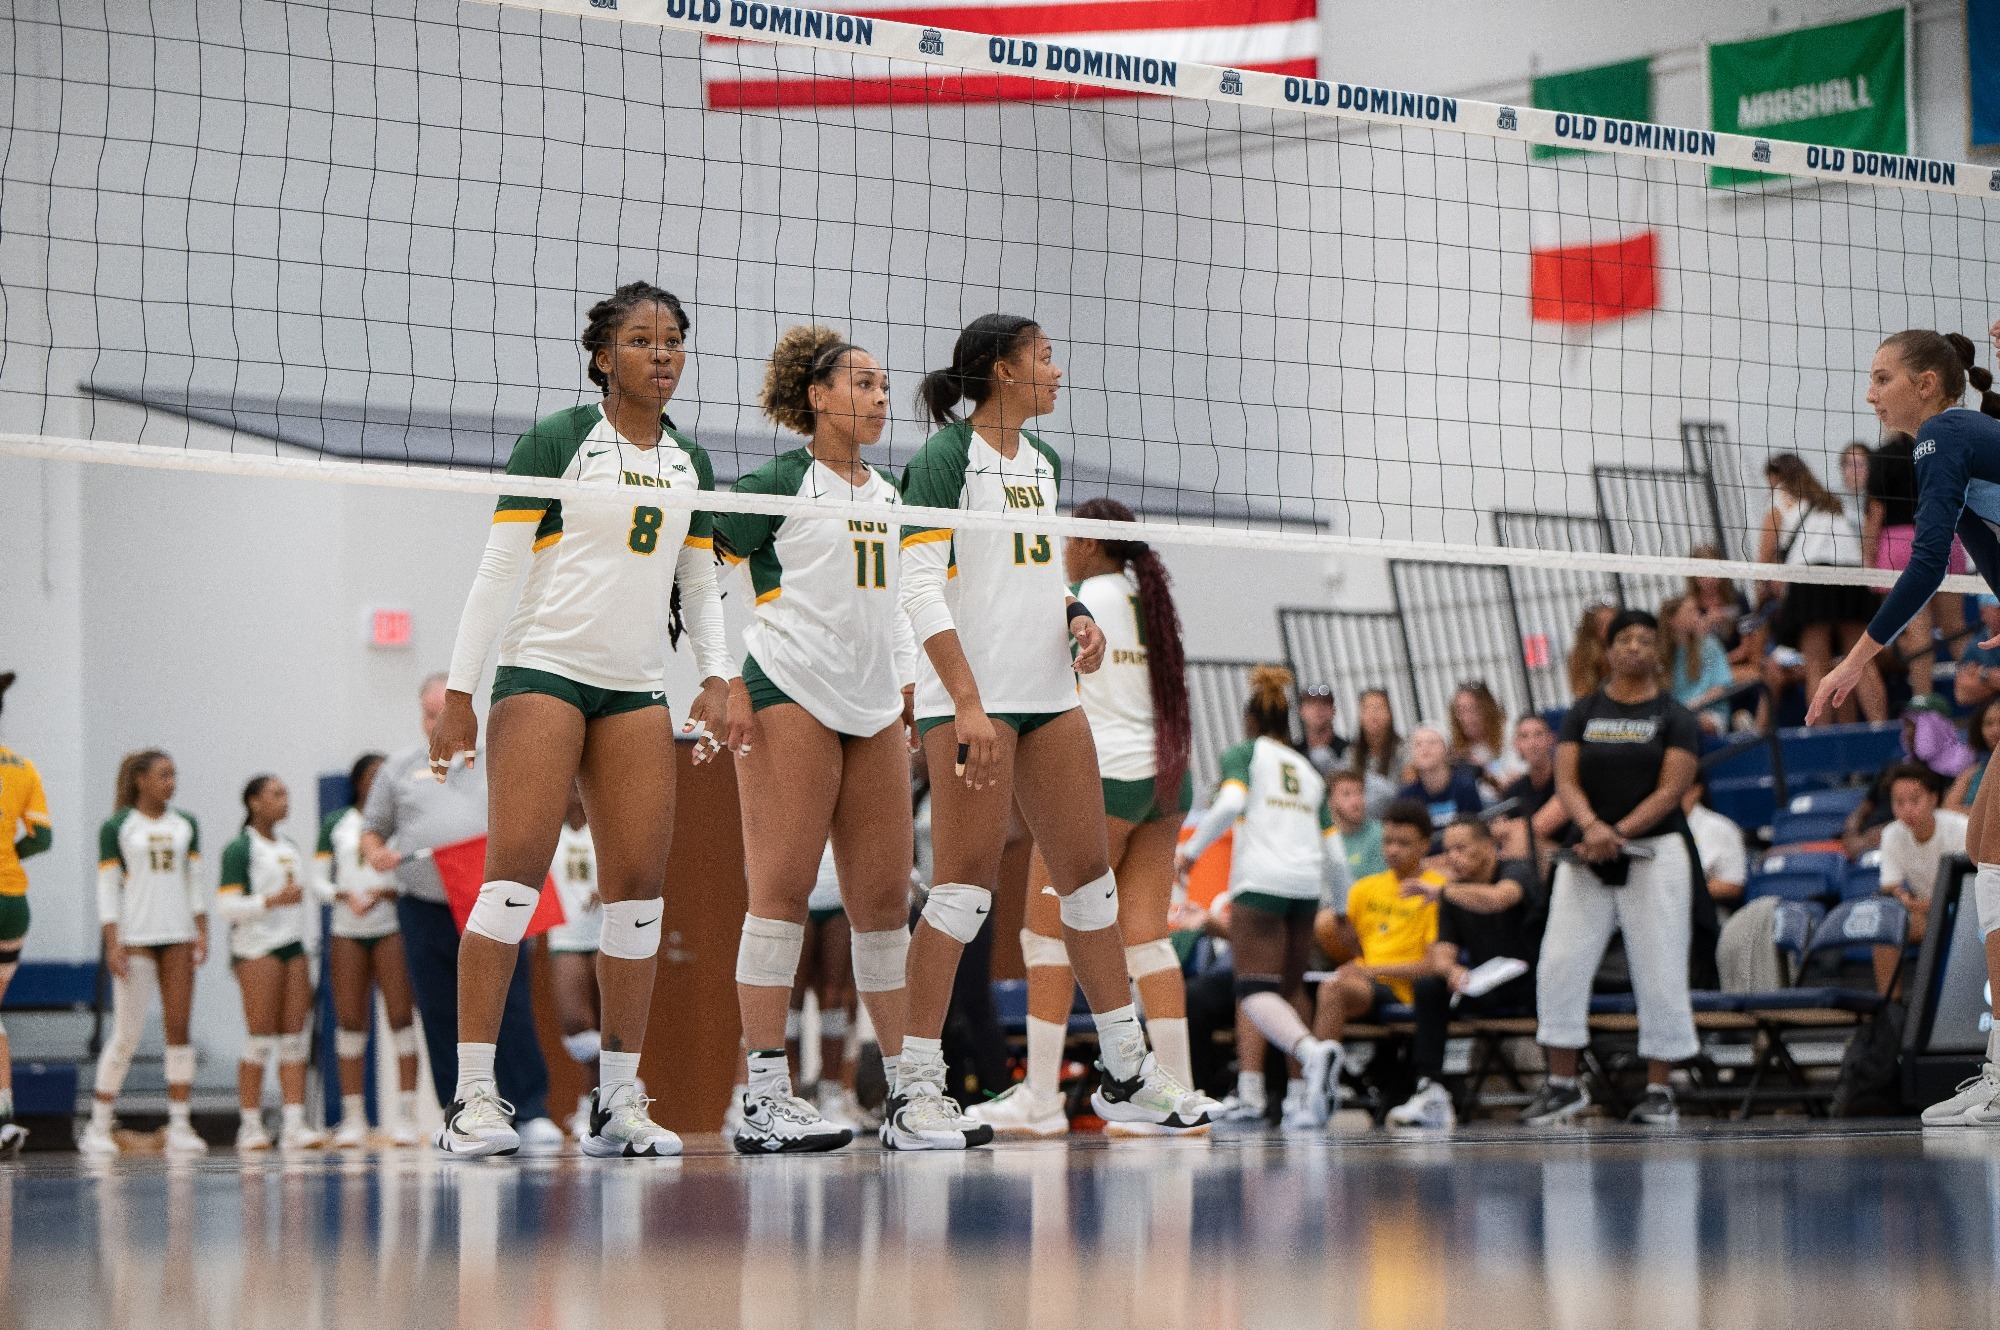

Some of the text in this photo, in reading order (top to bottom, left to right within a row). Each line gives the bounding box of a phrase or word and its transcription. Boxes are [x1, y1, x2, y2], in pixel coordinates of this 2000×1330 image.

[667, 0, 873, 45] OLD DOMINION
[988, 36, 1177, 88] OLD DOMINION
[1284, 77, 1457, 123] OLD DOMINION
[1737, 73, 1875, 130] MARSHALL
[1555, 113, 1716, 156] OLD DOMINION
[1807, 146, 1956, 185] OLD DOMINION
[1002, 485, 1045, 509] NSU
[627, 505, 664, 556] 8
[1013, 532, 1053, 566] 13
[853, 539, 887, 590] 11
